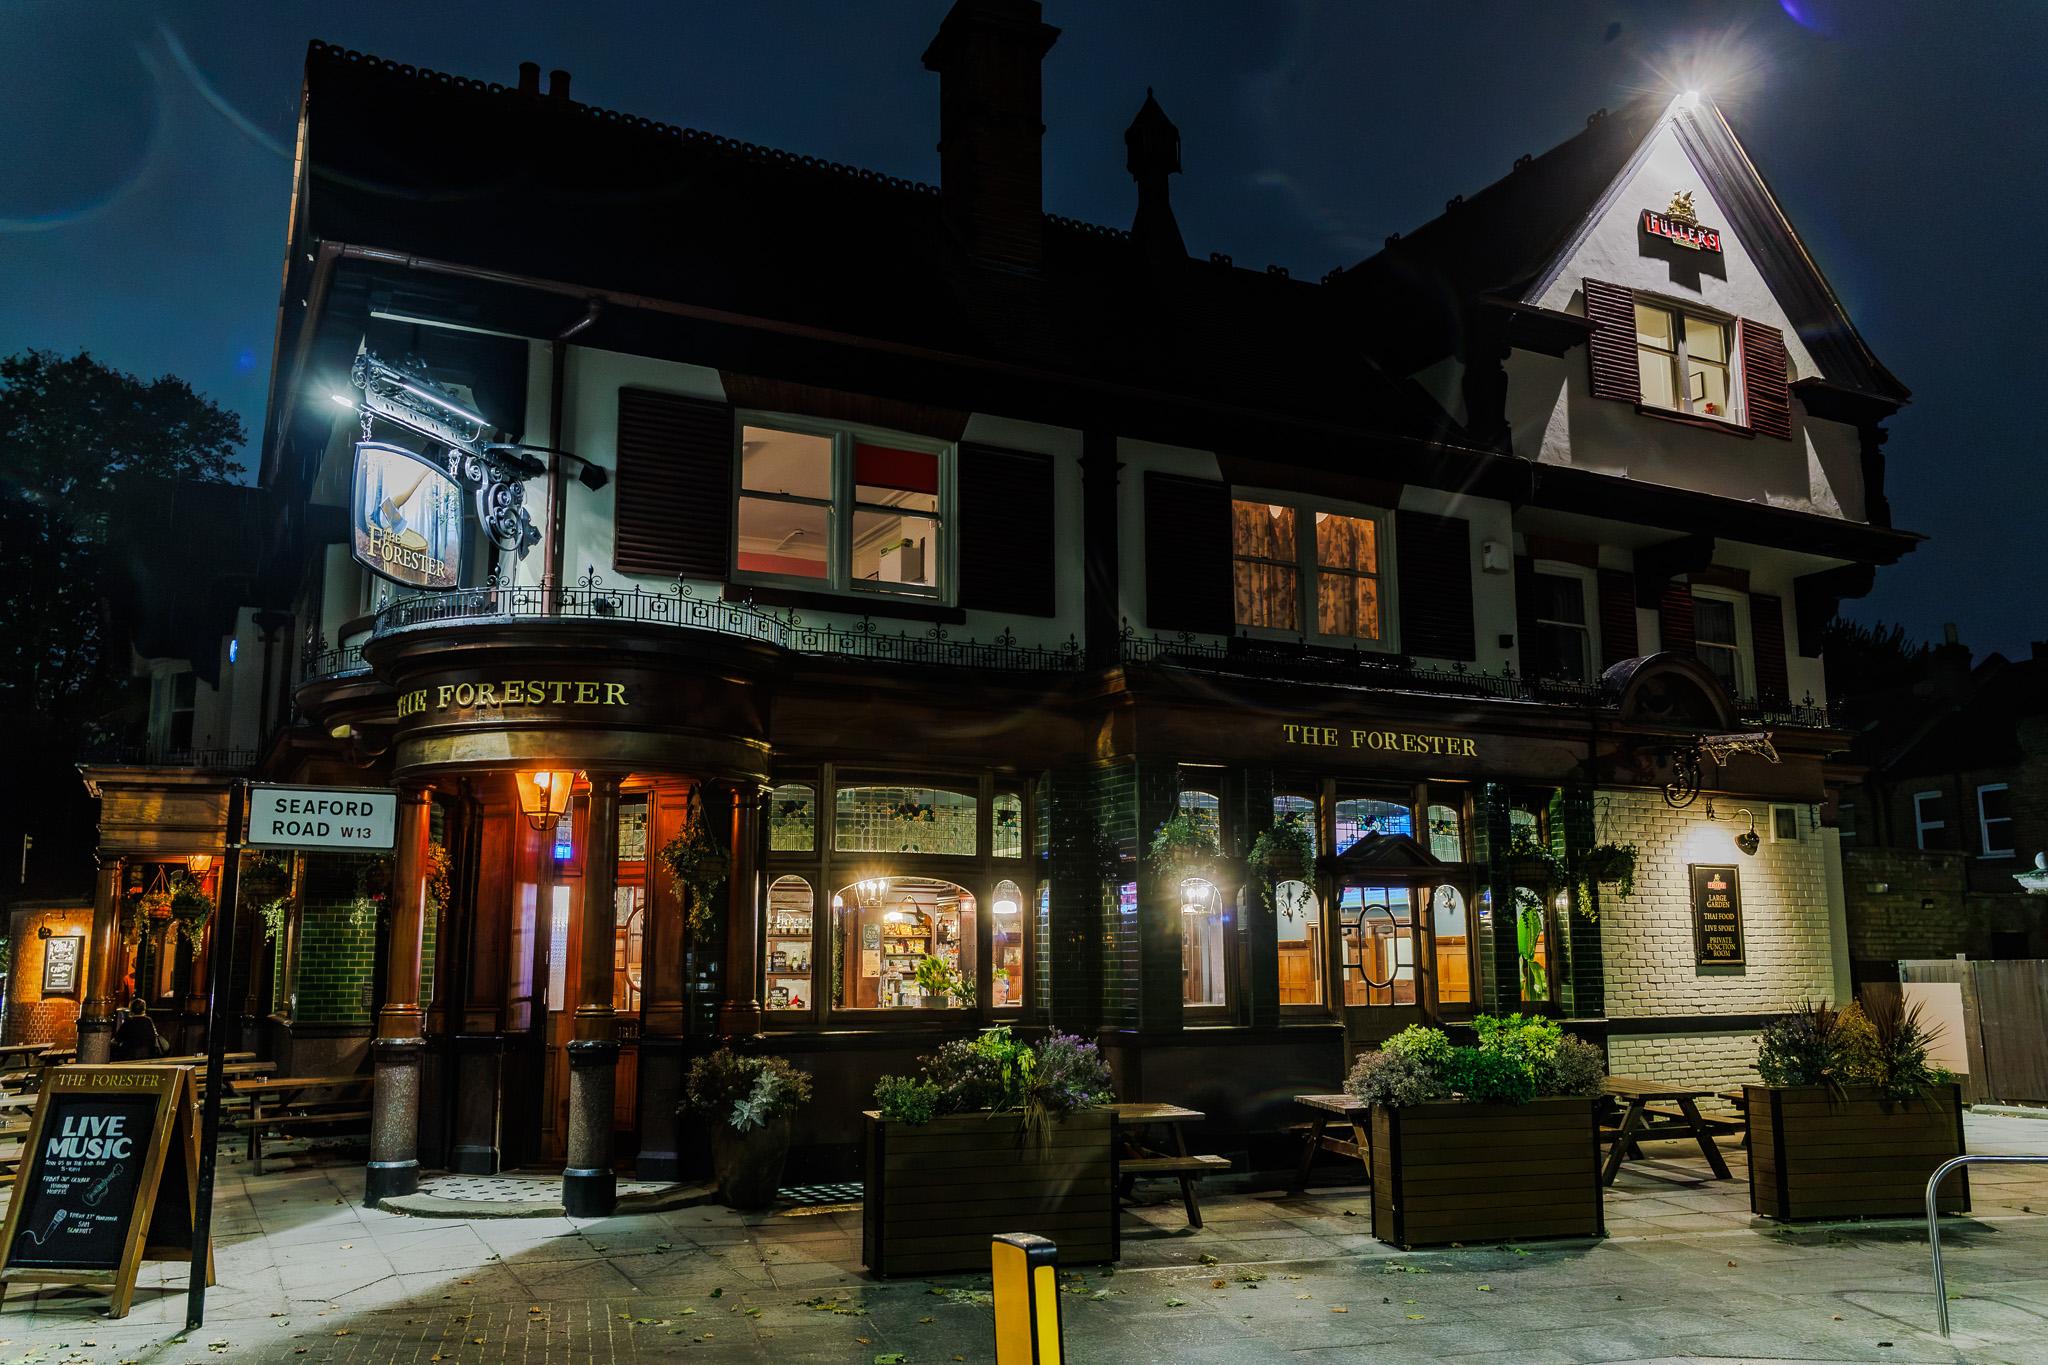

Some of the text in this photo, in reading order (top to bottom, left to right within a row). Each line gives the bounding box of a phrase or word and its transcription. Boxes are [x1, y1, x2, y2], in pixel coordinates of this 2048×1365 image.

[1650, 213, 1716, 247] FULLER'S
[383, 528, 401, 544] THE
[367, 525, 446, 578] FORESTER
[436, 680, 630, 709] FORESTER
[1283, 723, 1478, 757] THE FORESTER
[274, 798, 374, 817] SEAFORD
[272, 820, 372, 839] ROAD W13
[1708, 894, 1727, 902] LARGE
[1704, 924, 1718, 932] LIVE
[58, 1074, 159, 1087] THE FORESTER
[61, 1115, 127, 1137] LIVE
[45, 1137, 133, 1159] MUSIC
